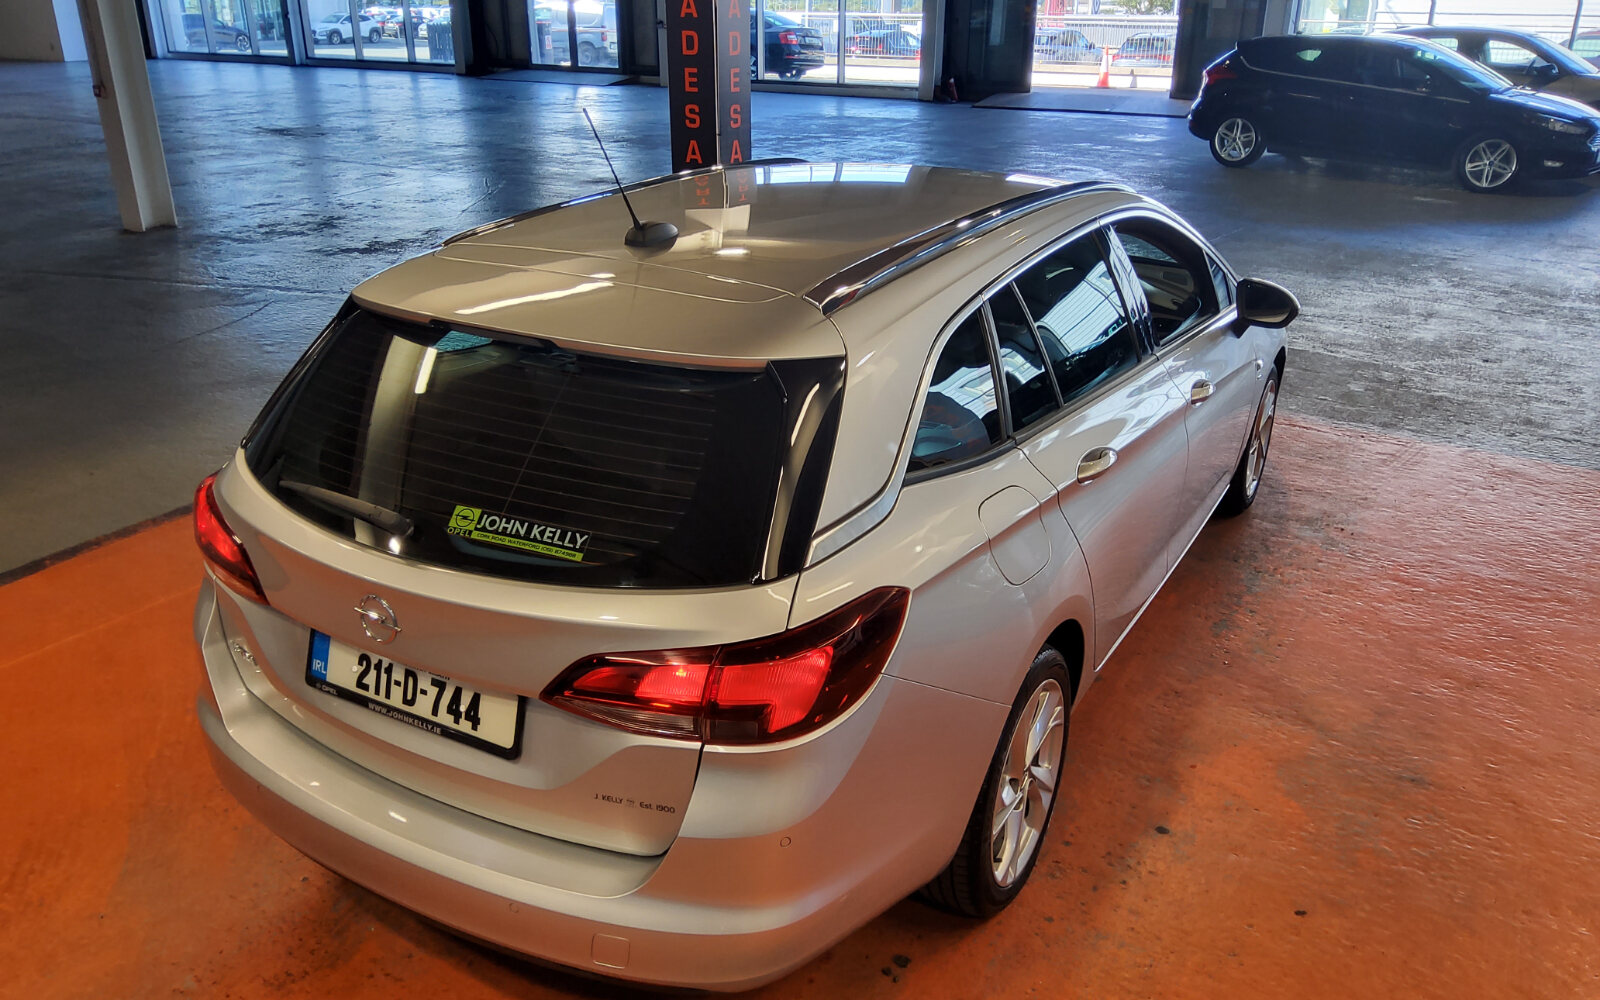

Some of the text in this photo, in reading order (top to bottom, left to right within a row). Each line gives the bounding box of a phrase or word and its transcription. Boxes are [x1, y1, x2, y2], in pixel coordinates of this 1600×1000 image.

[680, 0, 703, 164] ADESA
[728, 0, 743, 164] ADESA
[447, 526, 470, 537] OPEL
[476, 514, 588, 549] JOHN KELLY
[491, 535, 506, 543] ROAD
[507, 538, 540, 550] WATERFORD
[312, 658, 327, 674] IRL
[355, 653, 481, 732] 211-D-744
[368, 702, 442, 734] WWW.JOHNKELLY.IE
[601, 794, 624, 804] KELLY
[656, 804, 676, 814] 1900
